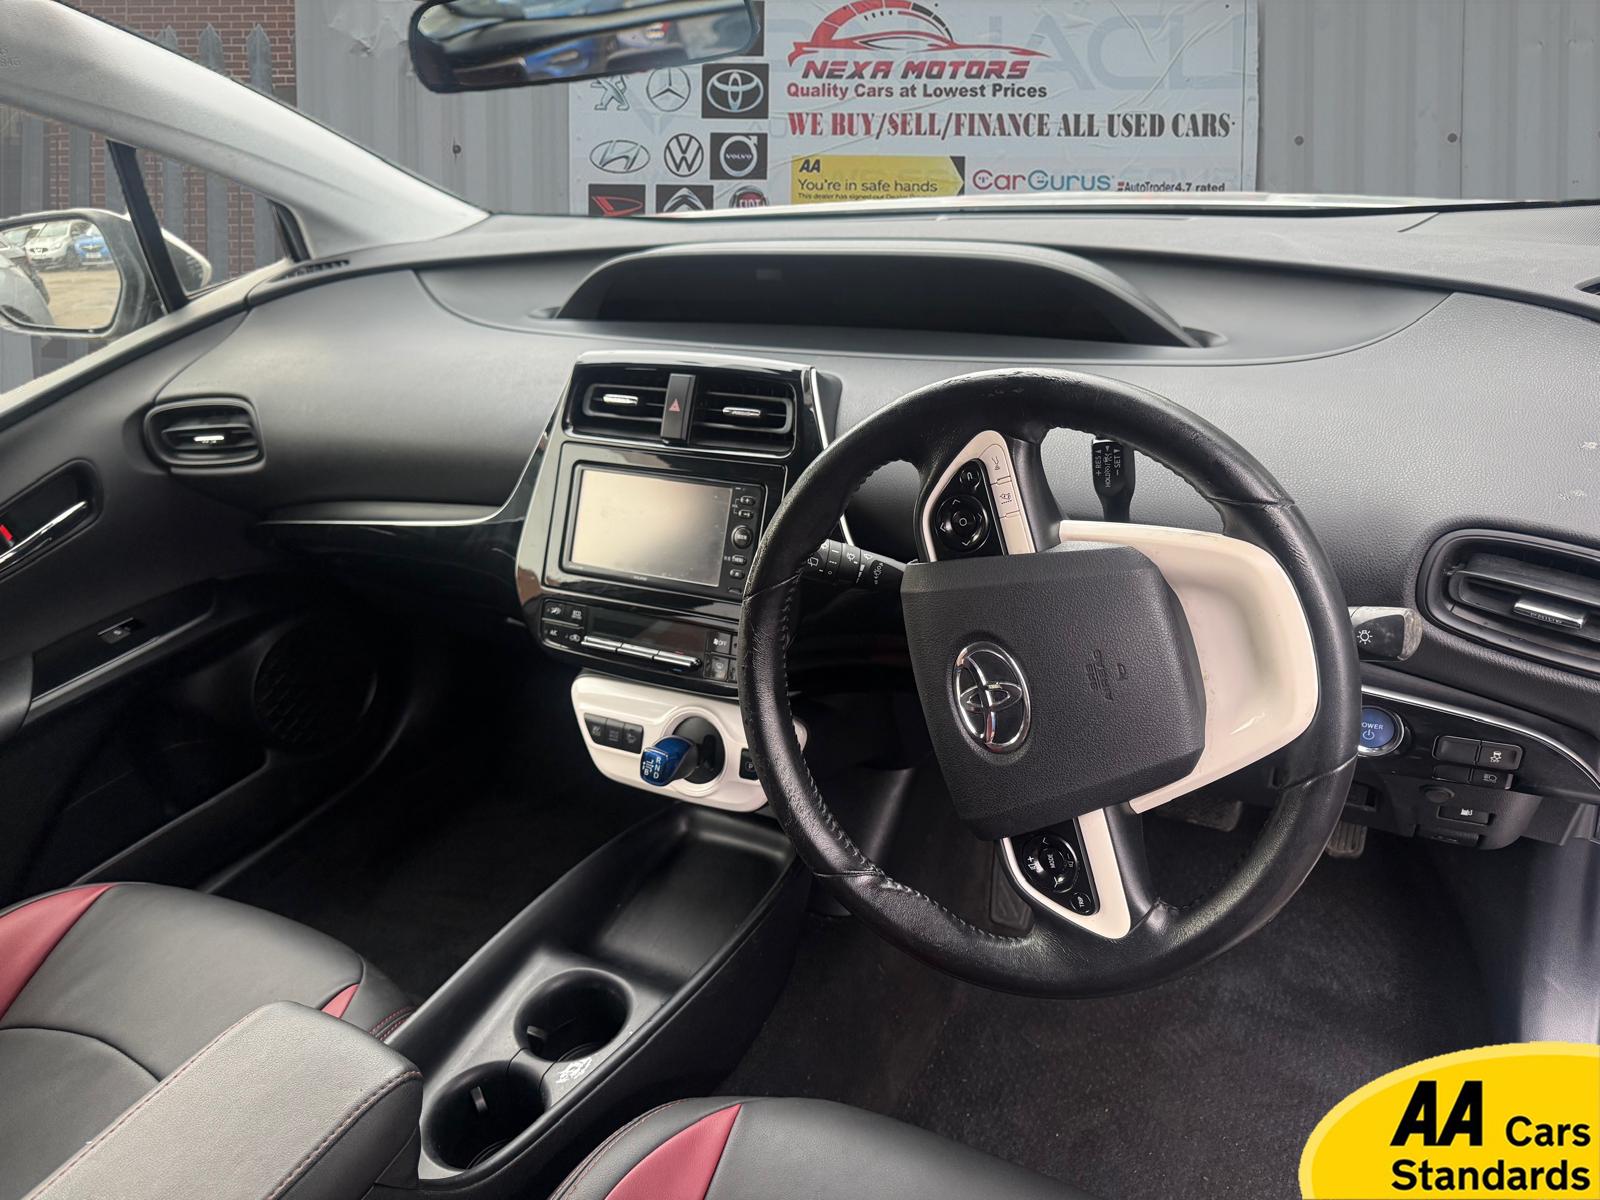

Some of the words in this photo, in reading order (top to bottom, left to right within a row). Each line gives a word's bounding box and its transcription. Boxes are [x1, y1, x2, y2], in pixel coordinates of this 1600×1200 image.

[802, 60, 894, 79] NEXA
[901, 60, 1030, 79] MOTORS
[787, 82, 849, 100] Quality
[854, 83, 894, 97] Cars
[900, 84, 917, 97] at
[923, 83, 986, 97] Lowest
[992, 83, 1047, 97] Prices
[788, 112, 823, 136] WE
[1057, 113, 1100, 137] ALL
[1107, 113, 1165, 138] USED
[1172, 112, 1231, 138] CARS
[799, 159, 821, 173] AA
[798, 179, 841, 192] You're
[845, 179, 857, 192] in
[861, 179, 891, 193] safe
[894, 180, 938, 193] hands
[972, 169, 1111, 191] CarGurus
[1195, 182, 1225, 192] rated
[1361, 721, 1384, 730] OWER
